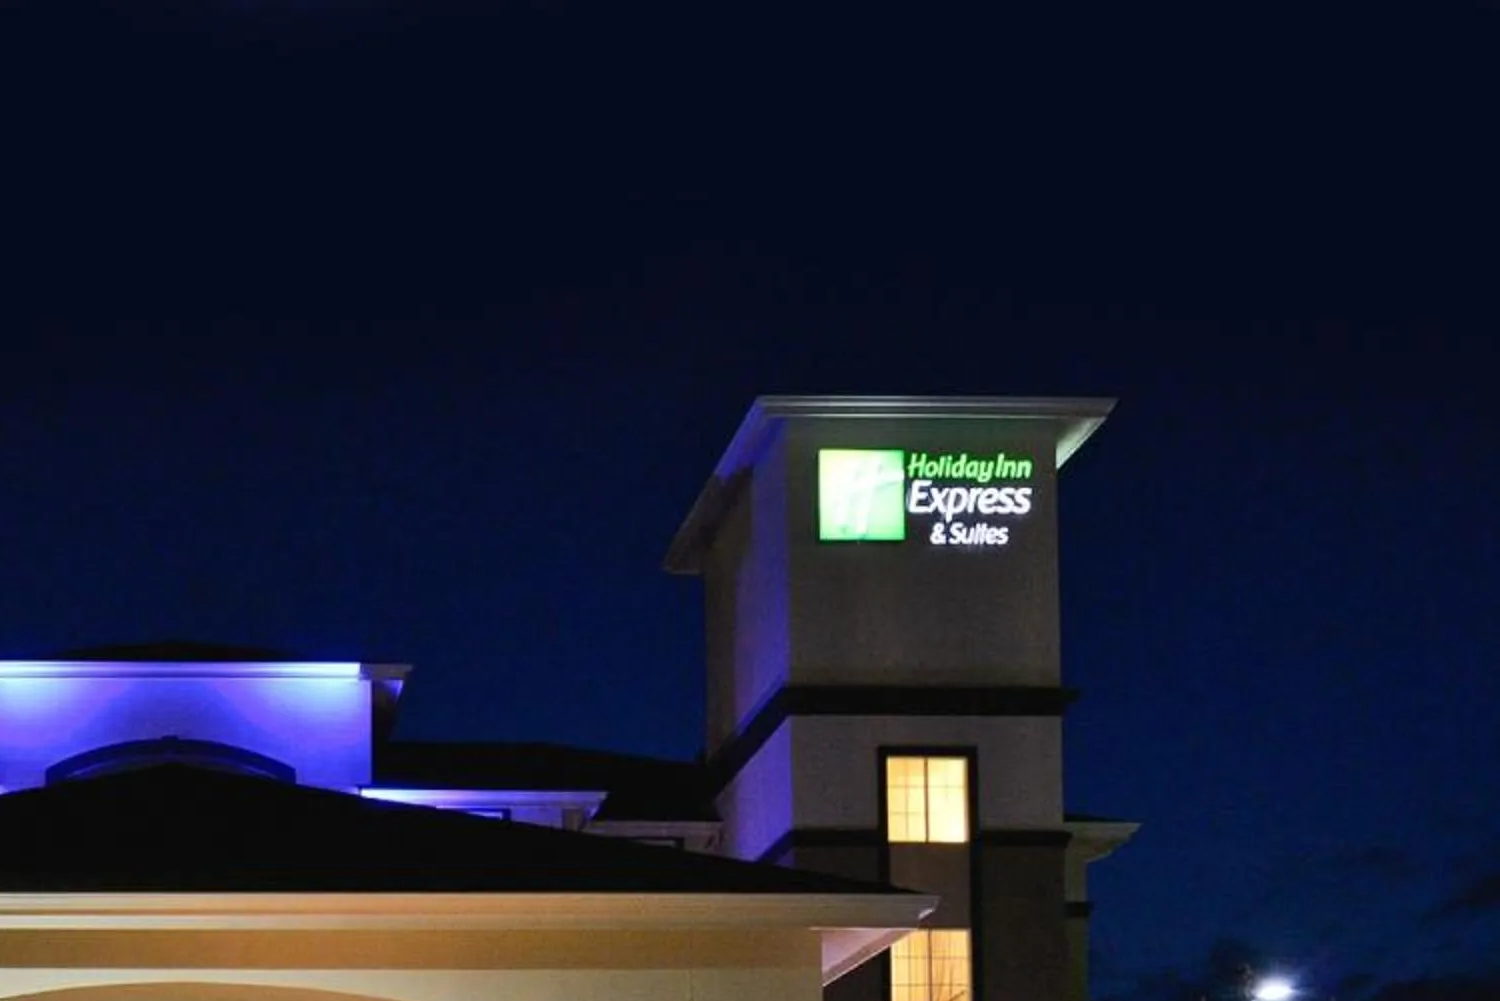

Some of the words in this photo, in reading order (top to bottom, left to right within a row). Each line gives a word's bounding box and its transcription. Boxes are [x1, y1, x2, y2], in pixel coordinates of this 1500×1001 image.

[908, 453, 994, 482] Holiday
[995, 453, 1032, 478] Inn
[908, 480, 1032, 522] Express
[930, 523, 946, 544] &
[948, 523, 1009, 544] Suites
